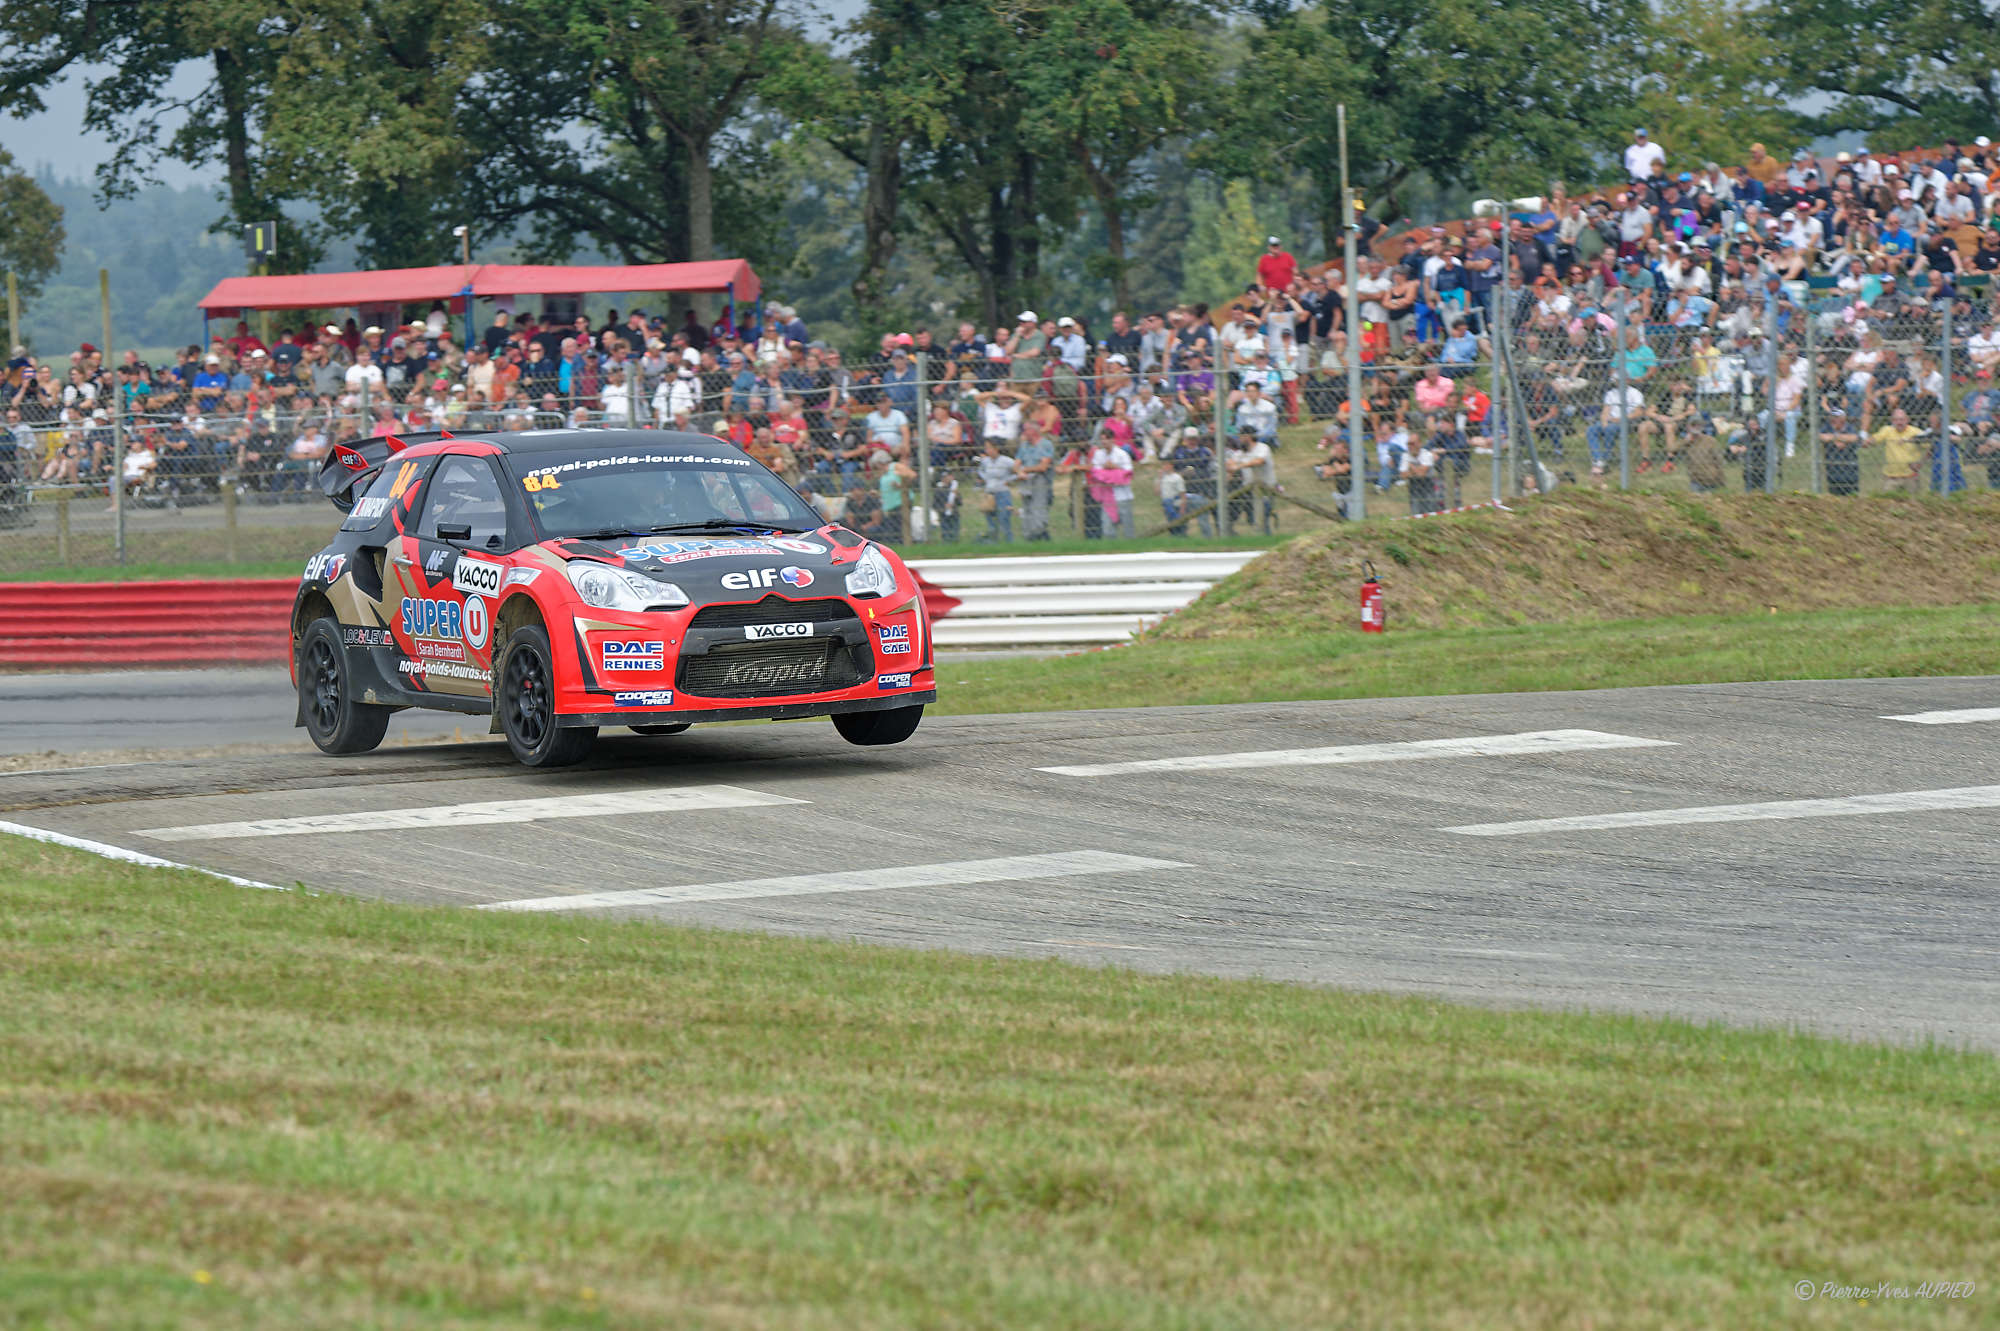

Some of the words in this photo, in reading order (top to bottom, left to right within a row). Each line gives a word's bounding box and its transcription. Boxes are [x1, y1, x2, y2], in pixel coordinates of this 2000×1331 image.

[527, 454, 750, 478] noyal-poids-lourds.com
[388, 461, 419, 499] 84
[522, 473, 561, 492] 84
[616, 539, 772, 561] SUPER
[669, 549, 706, 562] Sarah
[304, 554, 326, 580] elf
[458, 564, 498, 590] YACCO
[721, 568, 778, 590] elf
[401, 597, 463, 639] SUPER
[753, 624, 807, 637] YACCO
[879, 626, 908, 638] DAF
[418, 643, 434, 656] Sarah
[435, 644, 463, 659] Bernhardt
[604, 642, 663, 654] DAF
[882, 643, 910, 653] CAEN
[604, 660, 663, 670] RENNES
[722, 656, 827, 686] Knapick
[879, 673, 911, 684] COOPER
[615, 691, 673, 701] COOPER
